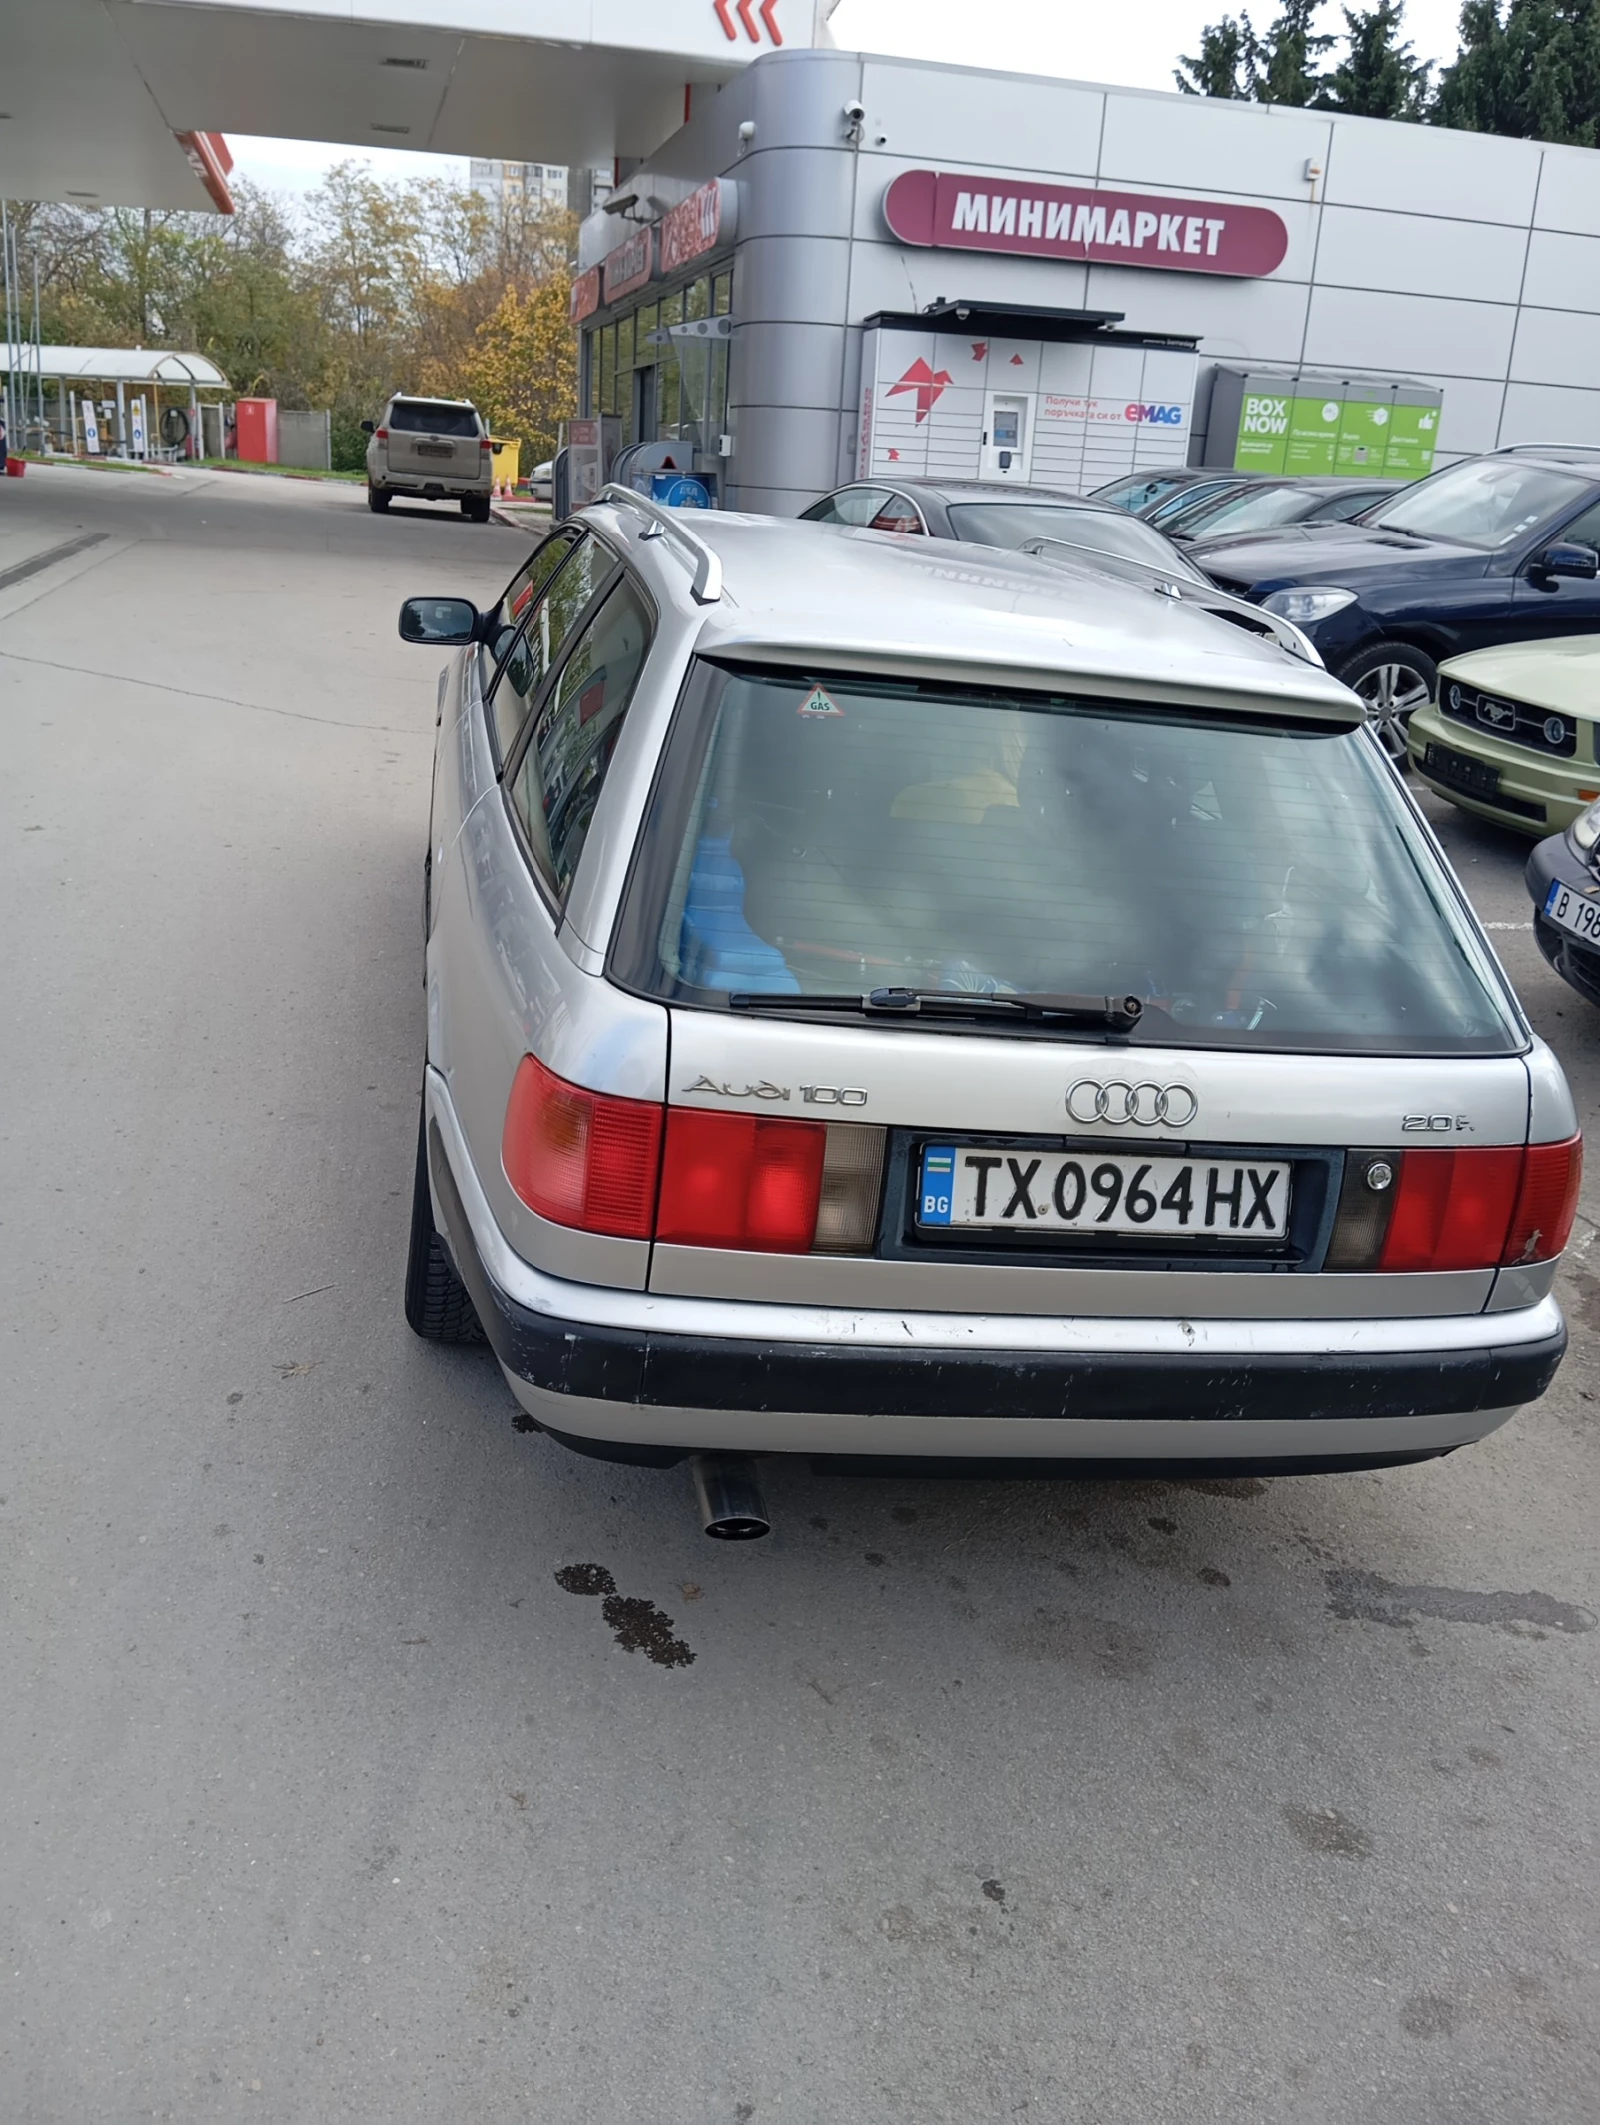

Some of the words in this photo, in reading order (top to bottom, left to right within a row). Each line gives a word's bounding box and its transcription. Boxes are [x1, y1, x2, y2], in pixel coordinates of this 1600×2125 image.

[952, 192, 1225, 255] МИНИМАРКЕТ
[1045, 395, 1081, 408] Получи
[1083, 400, 1098, 408] тук
[1245, 398, 1287, 418] BOX
[1044, 408, 1095, 419] поръчката
[1096, 412, 1108, 420] си
[1110, 413, 1122, 421] от
[1124, 403, 1182, 425] eMAG
[1243, 415, 1288, 435] NOW
[810, 701, 831, 711] GAS
[1557, 891, 1570, 918] B
[1574, 902, 1600, 938] 198
[682, 1075, 791, 1101] Audi
[800, 1084, 868, 1106] 100
[923, 1194, 949, 1214] BG
